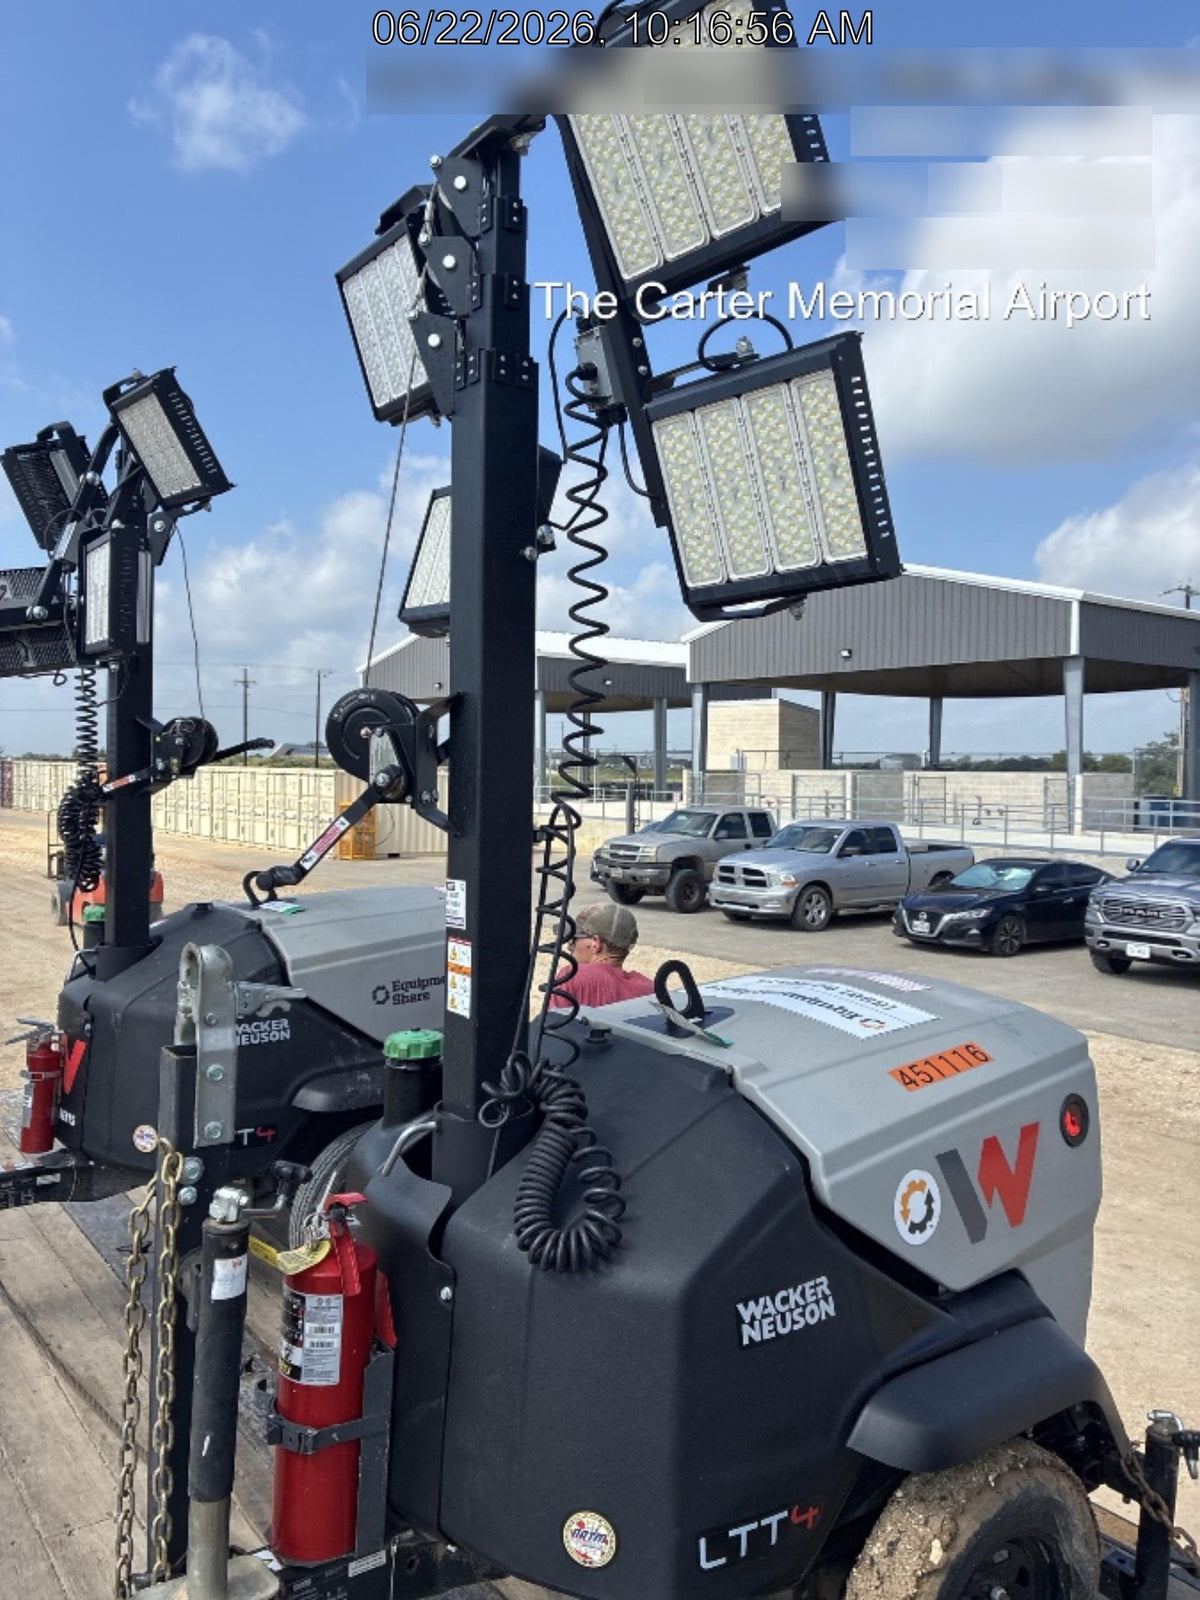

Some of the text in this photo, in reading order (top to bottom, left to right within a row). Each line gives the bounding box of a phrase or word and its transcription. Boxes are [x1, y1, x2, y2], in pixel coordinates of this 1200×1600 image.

[391, 976, 445, 991] Equipme
[391, 991, 432, 1005] Share
[899, 1044, 989, 1087] 451116
[736, 1276, 832, 1323] WACKER
[741, 1296, 836, 1346] NEUSON
[699, 1505, 819, 1570] LTT4
